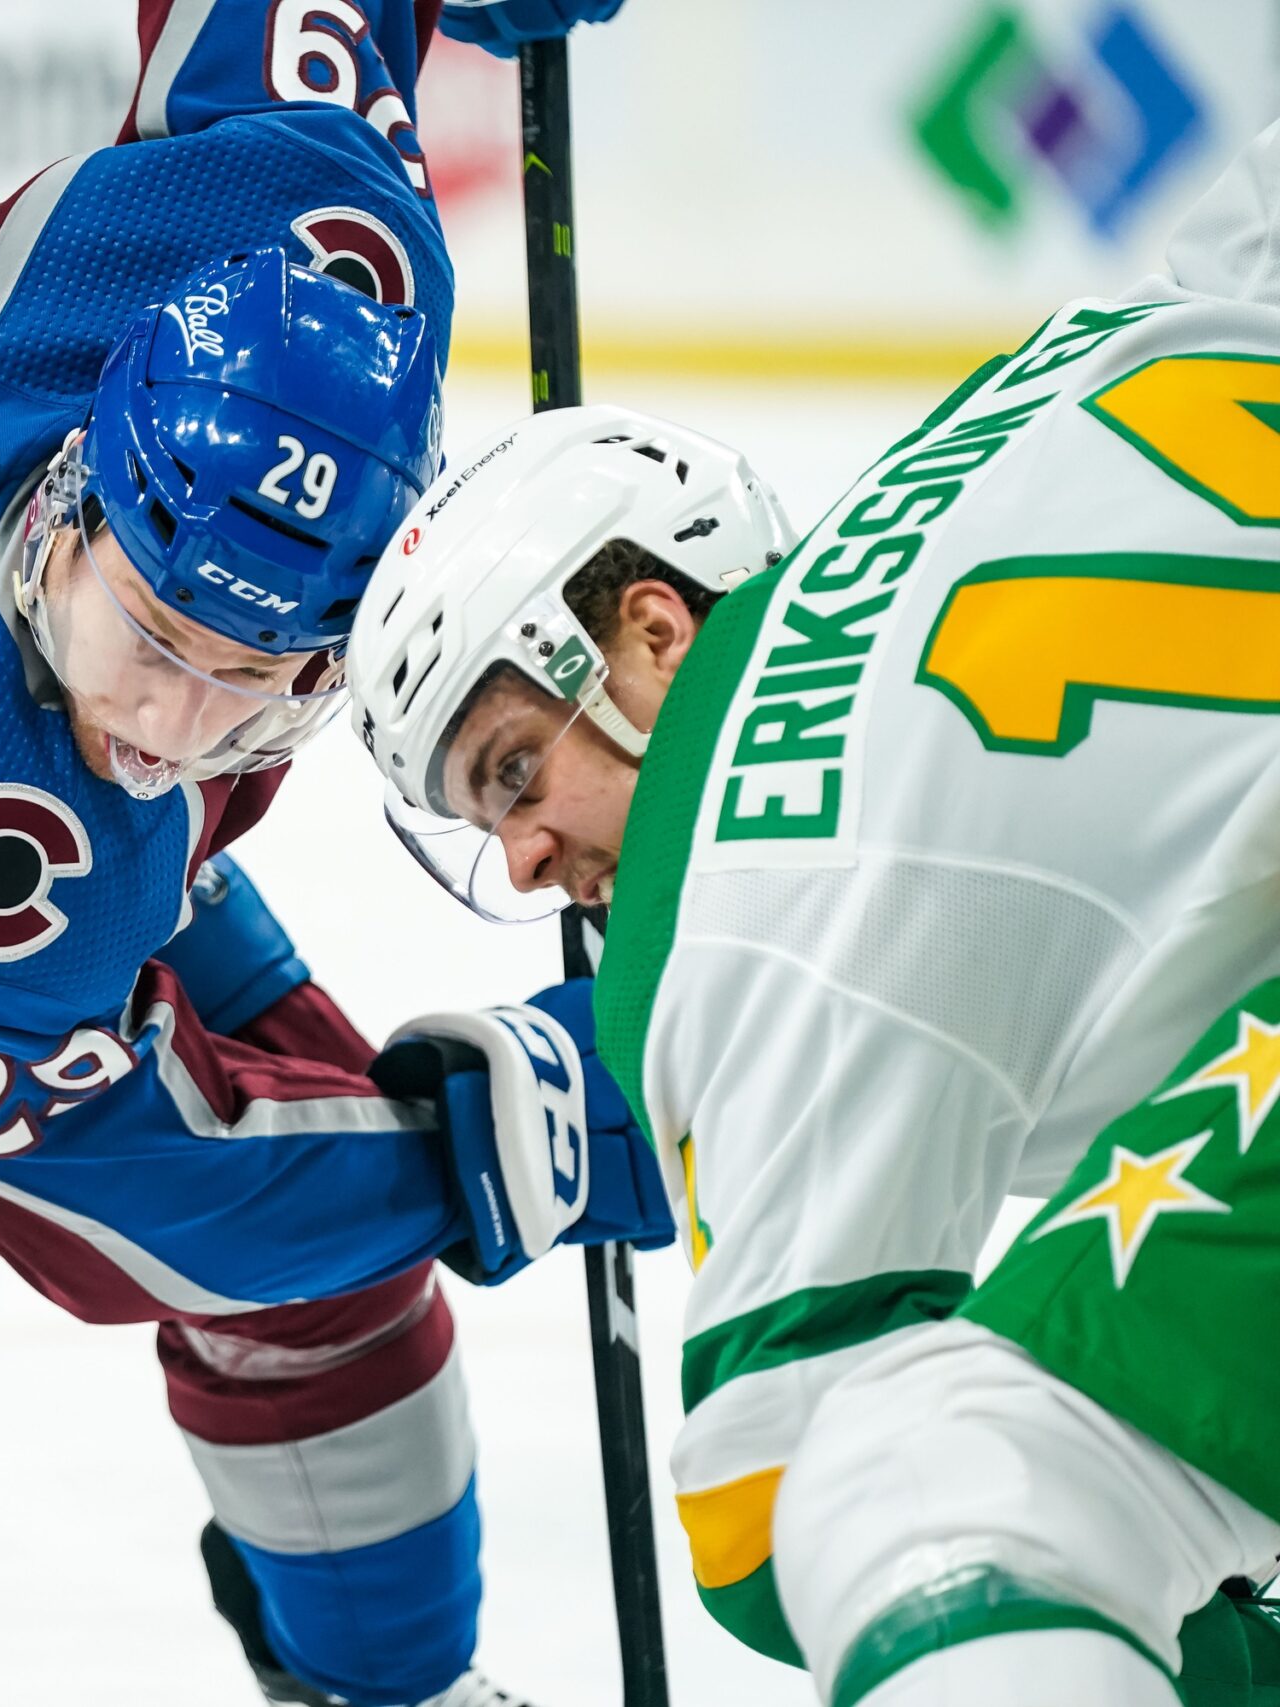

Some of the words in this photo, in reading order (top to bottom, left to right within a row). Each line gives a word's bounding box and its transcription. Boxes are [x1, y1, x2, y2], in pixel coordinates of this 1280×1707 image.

[170, 283, 229, 362] Ball
[257, 434, 339, 520] 29
[425, 479, 462, 522] Xcel
[460, 434, 515, 482] Energy
[196, 559, 300, 615] CCM
[715, 390, 1063, 842] ERIKSSON
[993, 301, 1193, 393] EK
[362, 706, 377, 761] CM
[492, 1005, 583, 1208] CC
